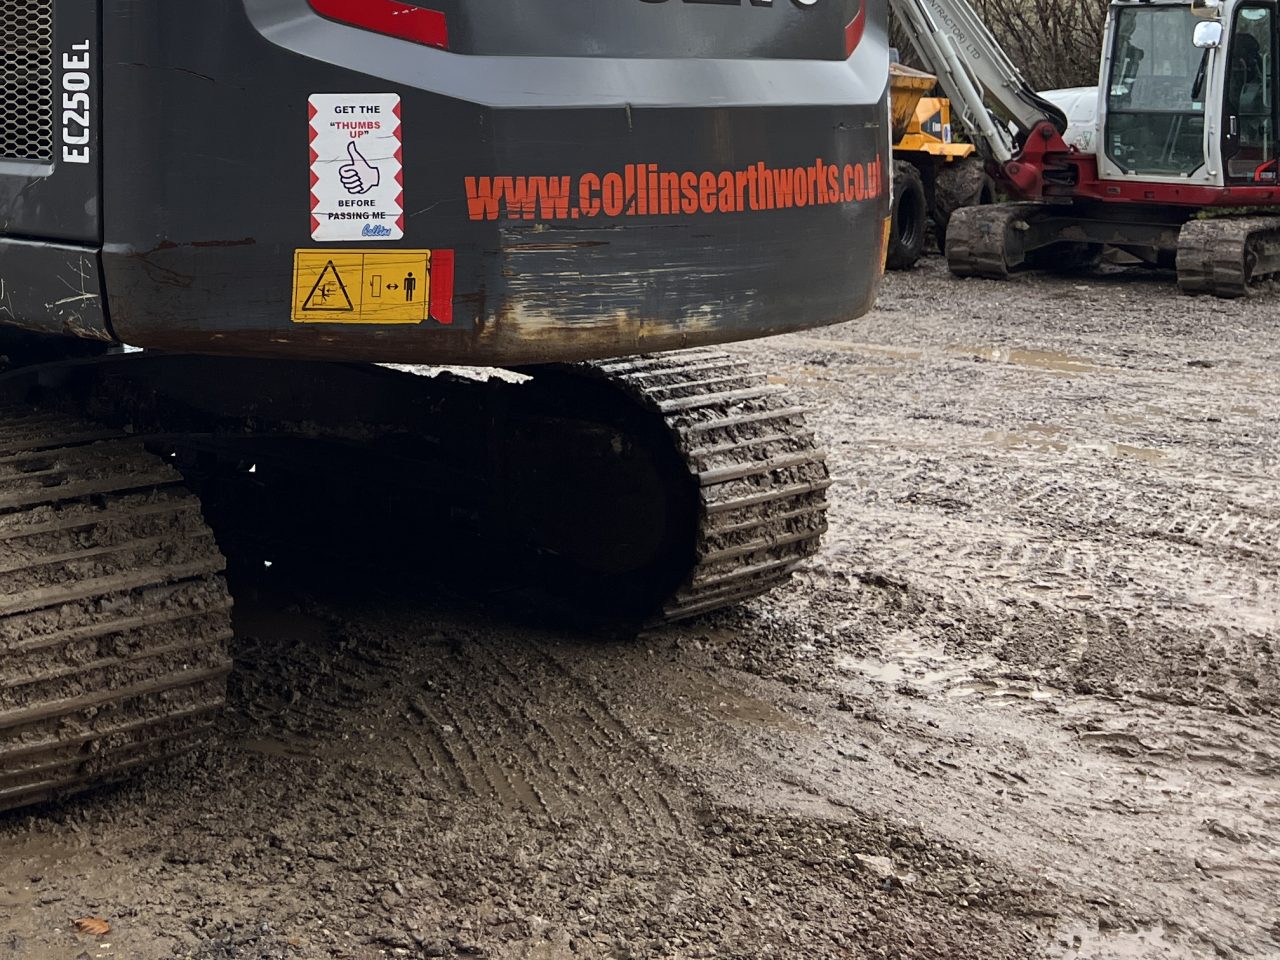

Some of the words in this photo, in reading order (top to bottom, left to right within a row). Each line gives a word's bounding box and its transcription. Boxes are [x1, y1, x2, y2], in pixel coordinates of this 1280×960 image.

[966, 43, 980, 59] LTD
[334, 105, 355, 114] GET
[359, 105, 381, 114] THE
[338, 199, 376, 208] BEFORE
[328, 211, 370, 221] PASSING
[372, 211, 387, 220] ME
[361, 222, 392, 237] Collins
